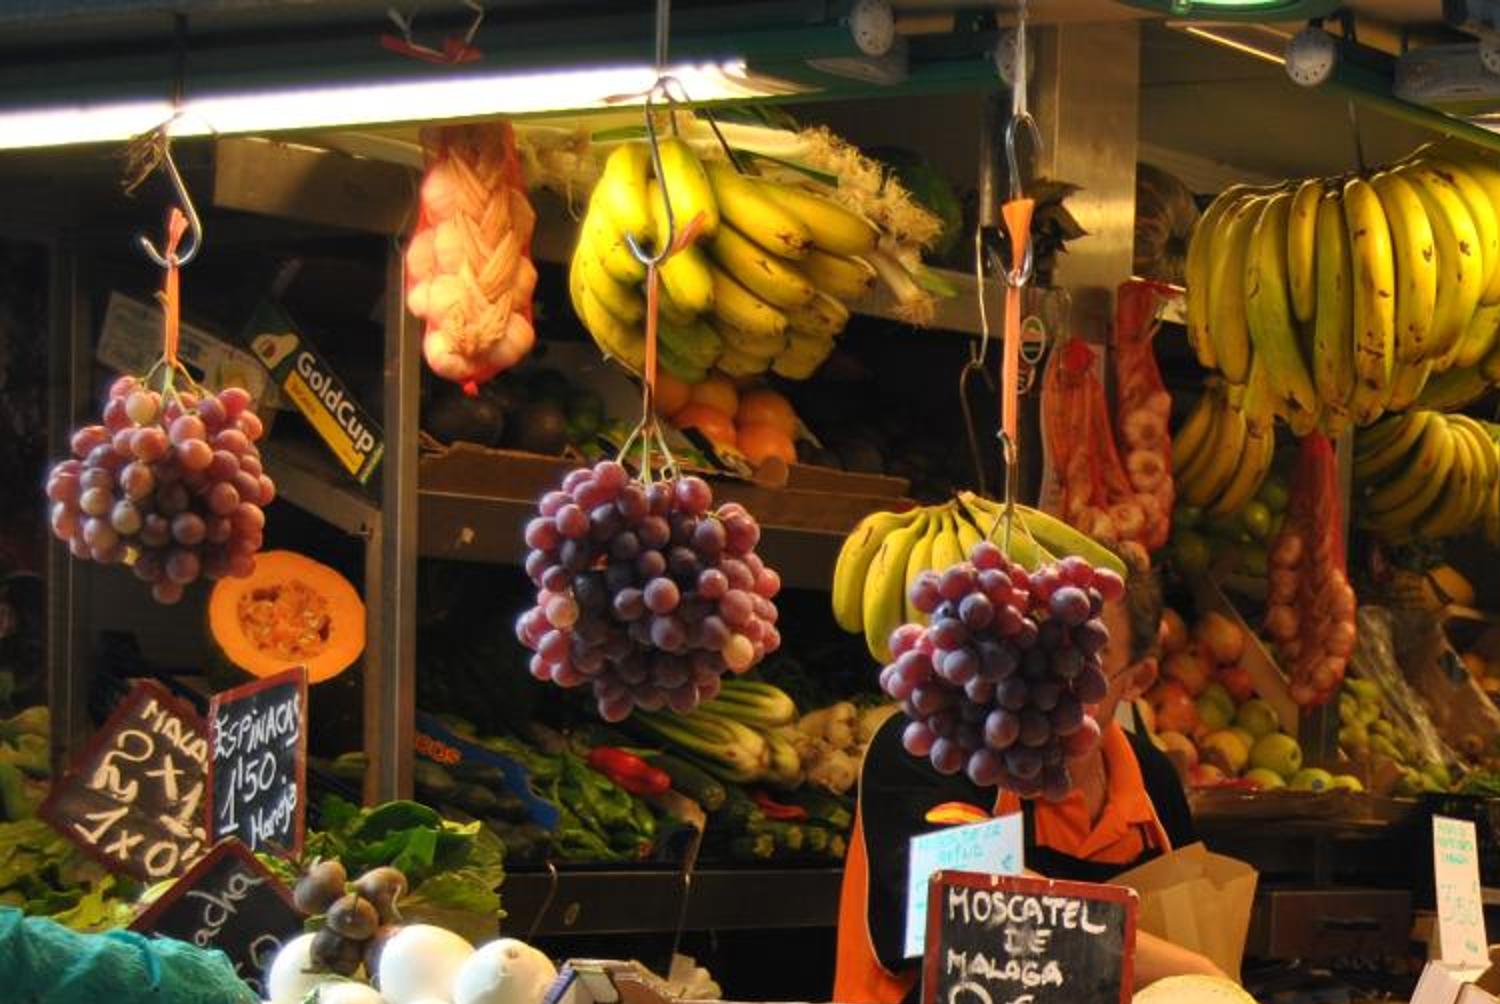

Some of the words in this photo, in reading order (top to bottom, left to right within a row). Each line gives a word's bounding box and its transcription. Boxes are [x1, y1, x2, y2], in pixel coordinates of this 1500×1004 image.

[296, 351, 374, 453] GoldCup
[140, 699, 208, 773] MALA
[213, 693, 299, 761] ESPINACAS
[948, 887, 1107, 934] MOSCATEL
[946, 949, 1065, 988] MALAGA
[1003, 929, 1051, 954] DE
